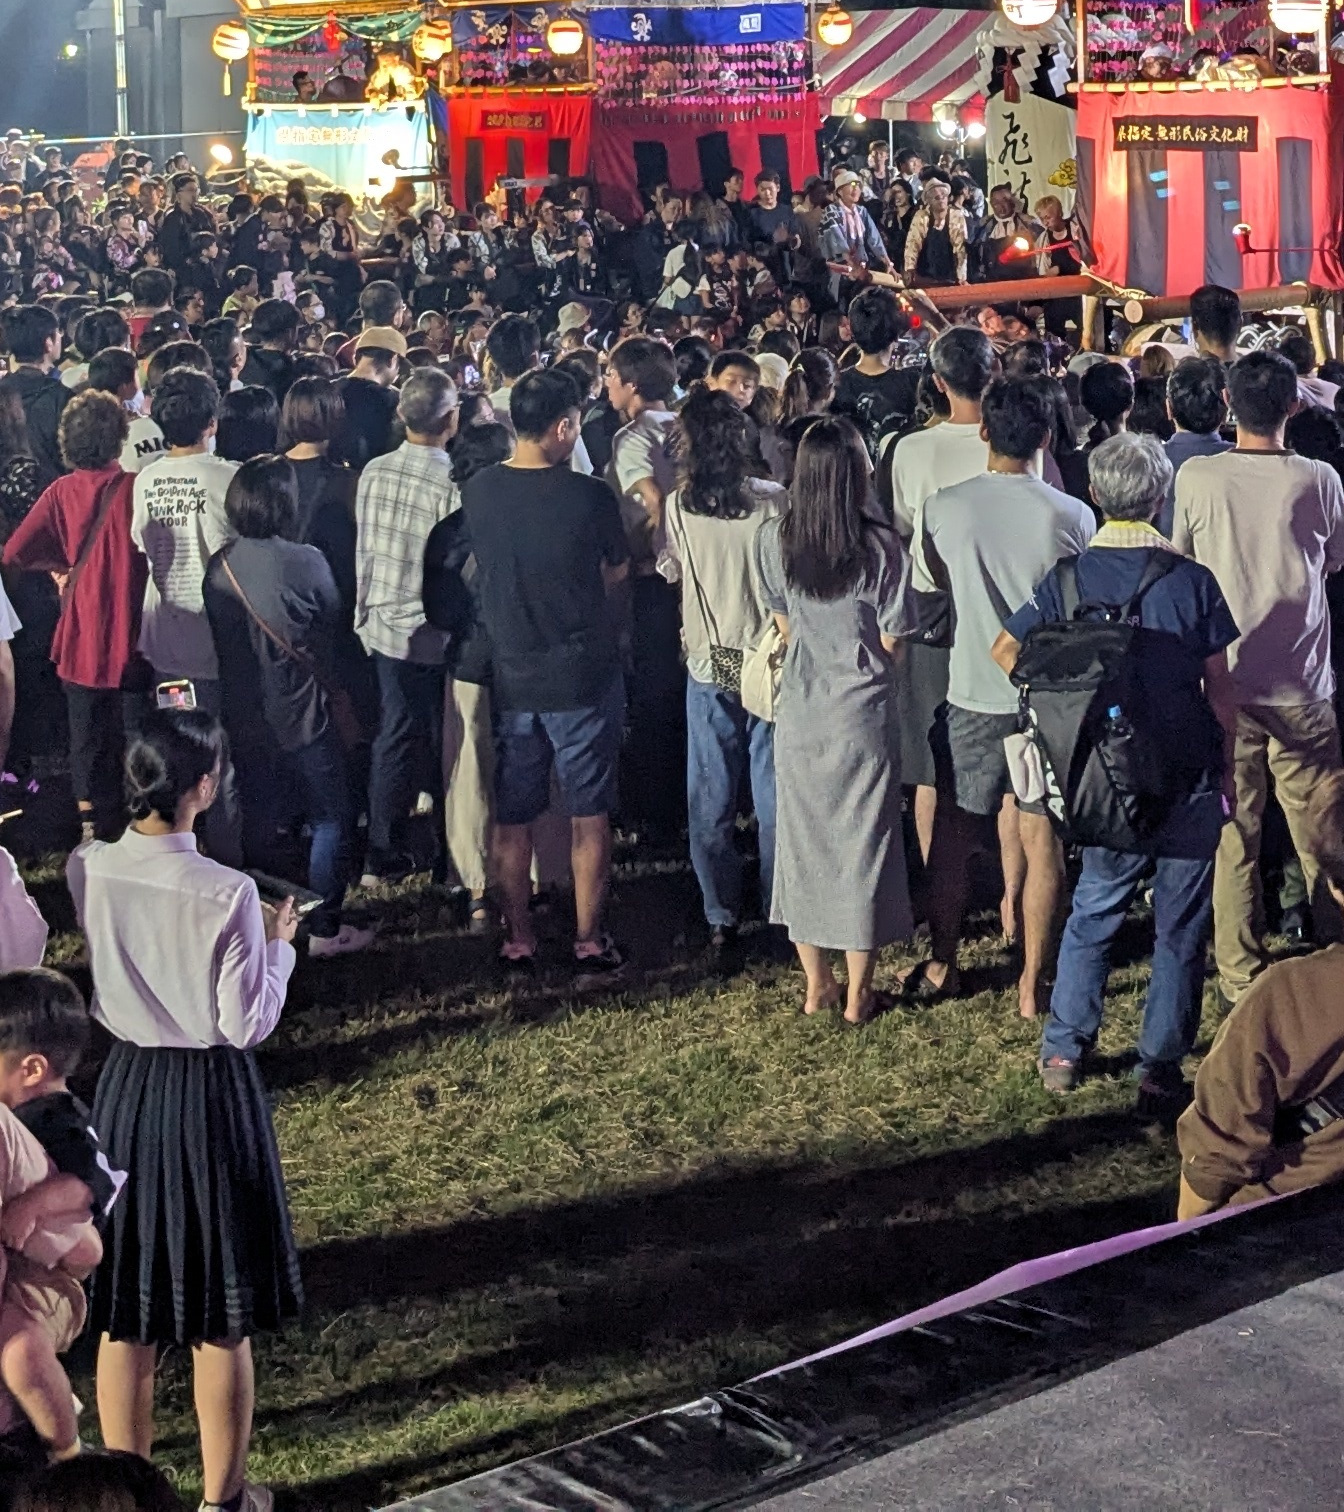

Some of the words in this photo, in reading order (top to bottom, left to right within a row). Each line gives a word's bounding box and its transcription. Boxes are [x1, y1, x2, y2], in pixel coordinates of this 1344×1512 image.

[147, 502, 174, 519] PUNK
[176, 499, 206, 515] ROCK
[159, 516, 188, 528] TOUR
